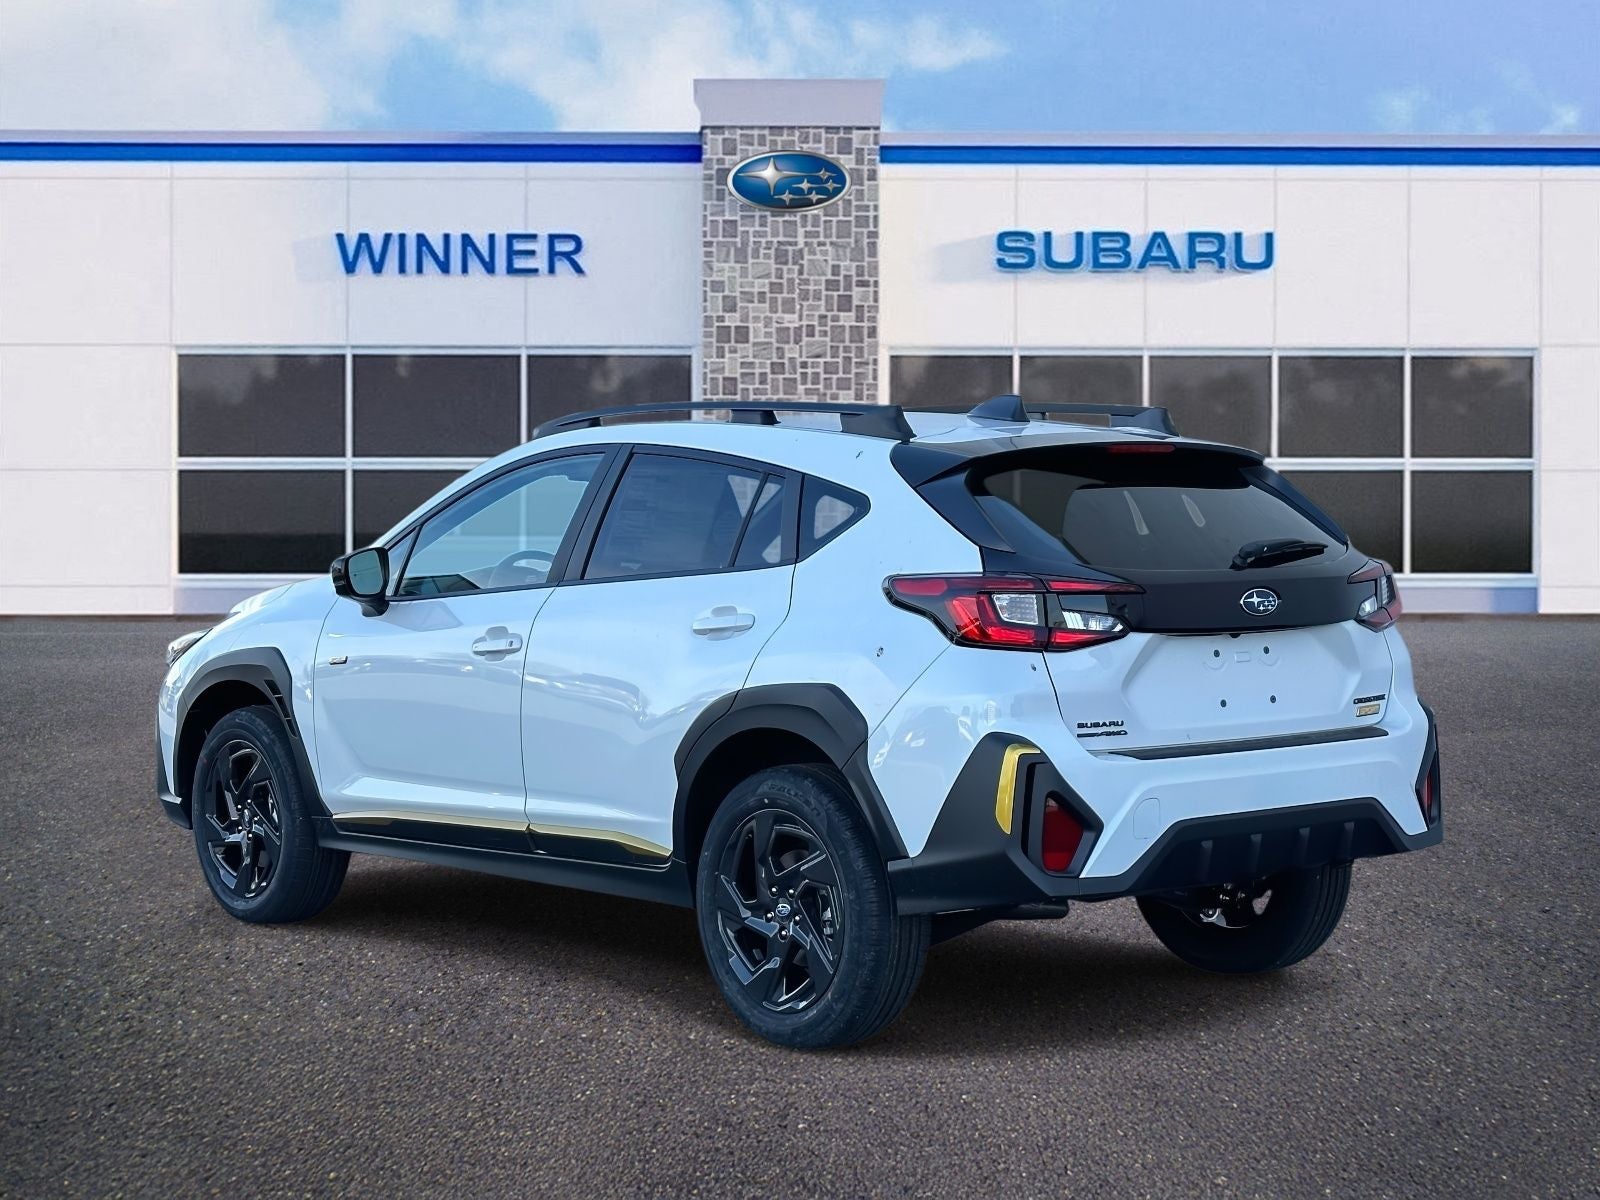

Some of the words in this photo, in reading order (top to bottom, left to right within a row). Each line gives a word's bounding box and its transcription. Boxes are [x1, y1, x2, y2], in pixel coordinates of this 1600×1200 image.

[335, 232, 586, 276] WINNER
[996, 230, 1275, 271] SUBARU
[1077, 720, 1124, 728] SUBARU
